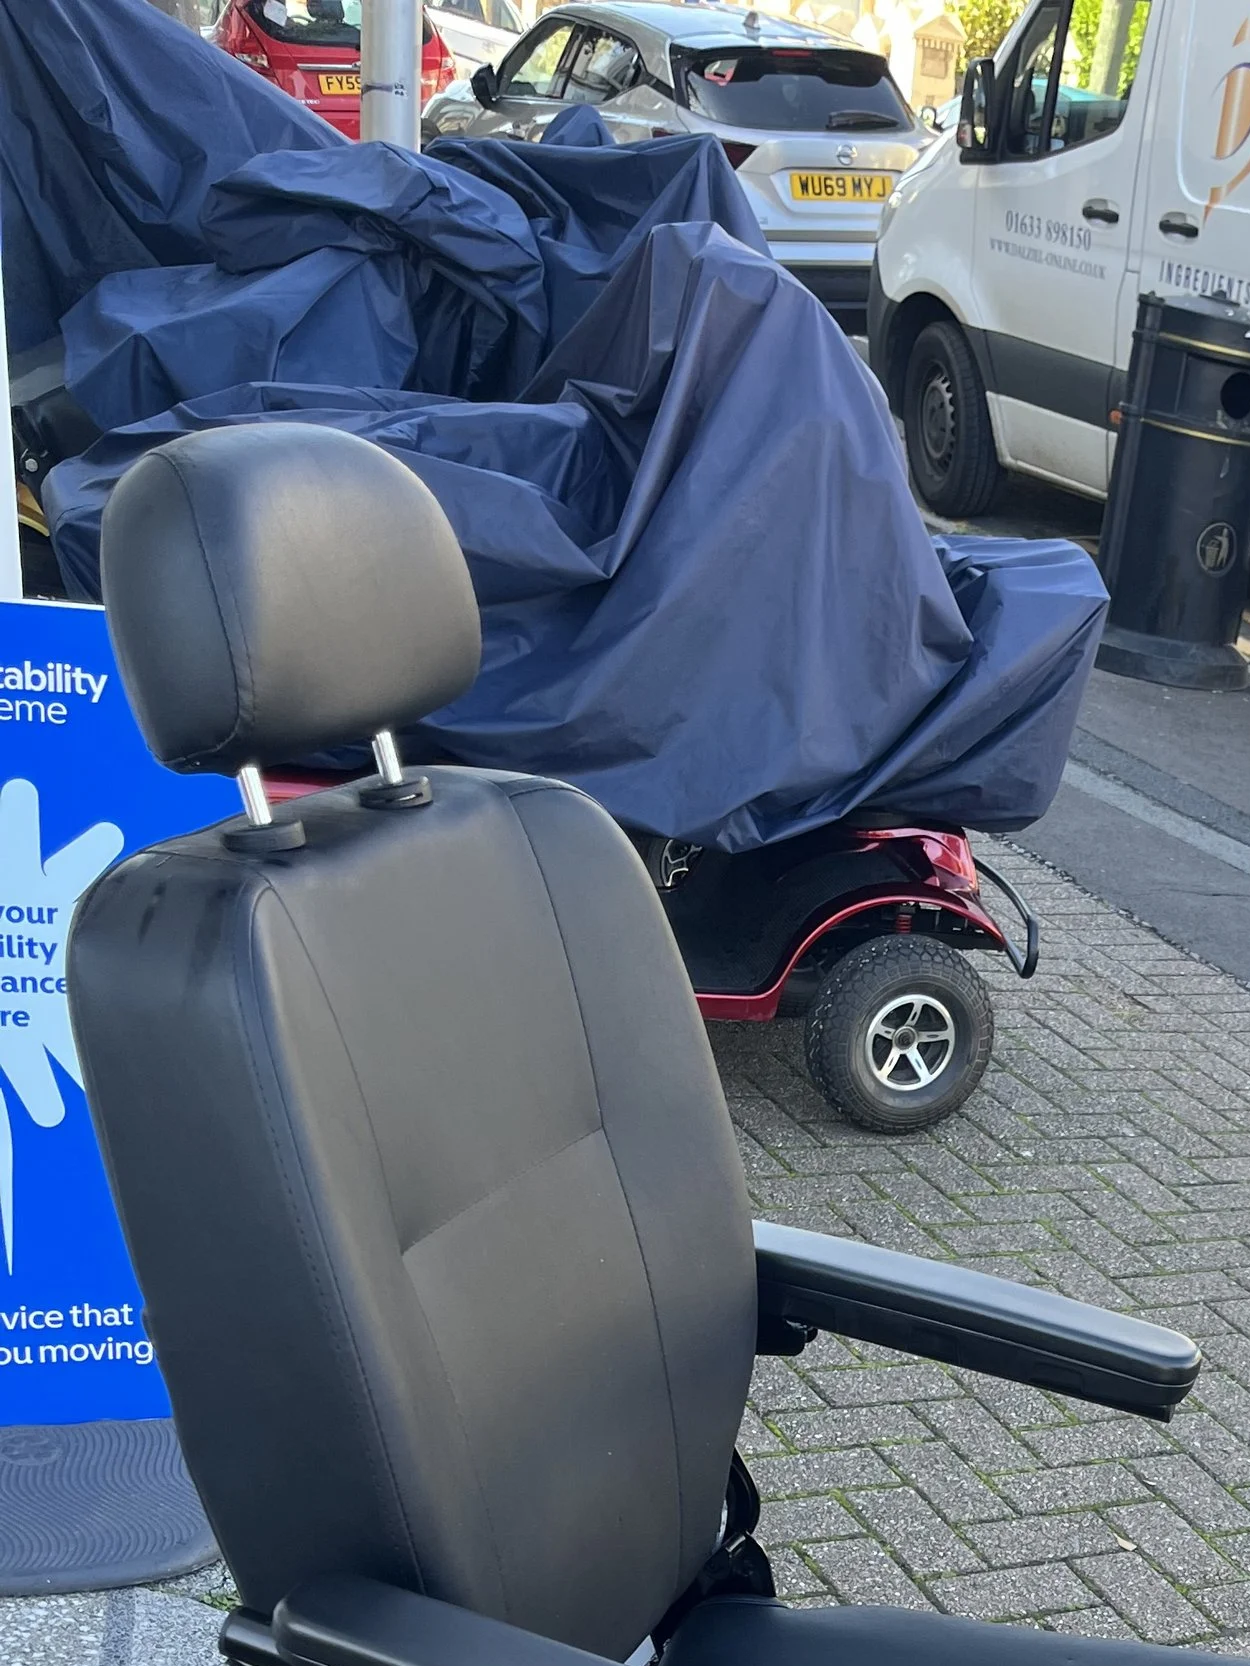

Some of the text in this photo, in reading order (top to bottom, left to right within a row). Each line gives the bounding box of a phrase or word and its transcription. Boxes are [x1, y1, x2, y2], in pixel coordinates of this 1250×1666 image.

[799, 174, 886, 198] WU69 MYJ
[1005, 209, 1092, 252] 01633 898150
[69, 1303, 133, 1327] that
[39, 1337, 154, 1364] moving
